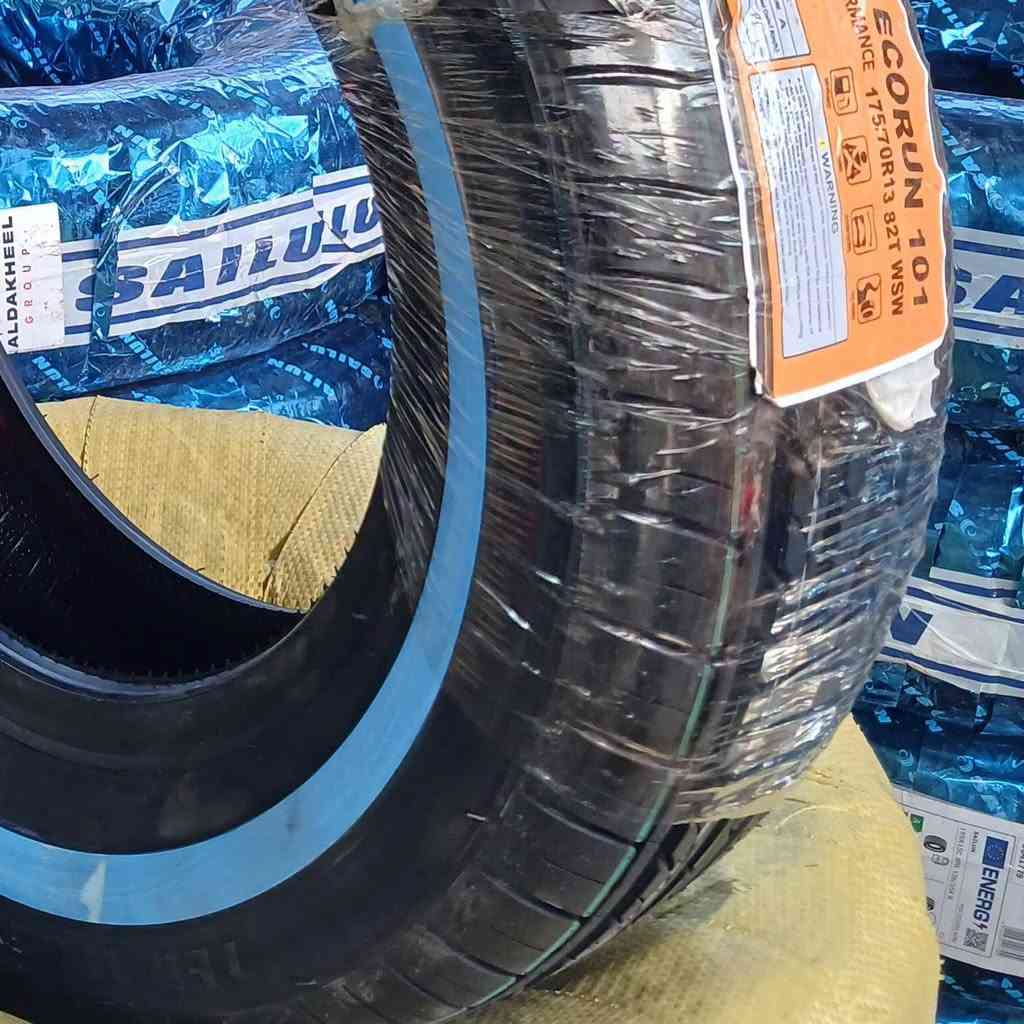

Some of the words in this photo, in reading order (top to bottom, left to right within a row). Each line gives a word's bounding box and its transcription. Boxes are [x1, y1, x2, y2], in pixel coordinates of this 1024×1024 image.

[822, 152, 839, 234] WARNING
[872, 7, 924, 209] ECORUN
[908, 228, 930, 306] 101
[76, 220, 325, 312] SAILU
[883, 214, 902, 252] 82T
[0, 215, 19, 349] ALDAKHEEL
[21, 247, 34, 325] GROUP
[890, 260, 905, 316] WSW
[974, 867, 999, 924] ENERG
